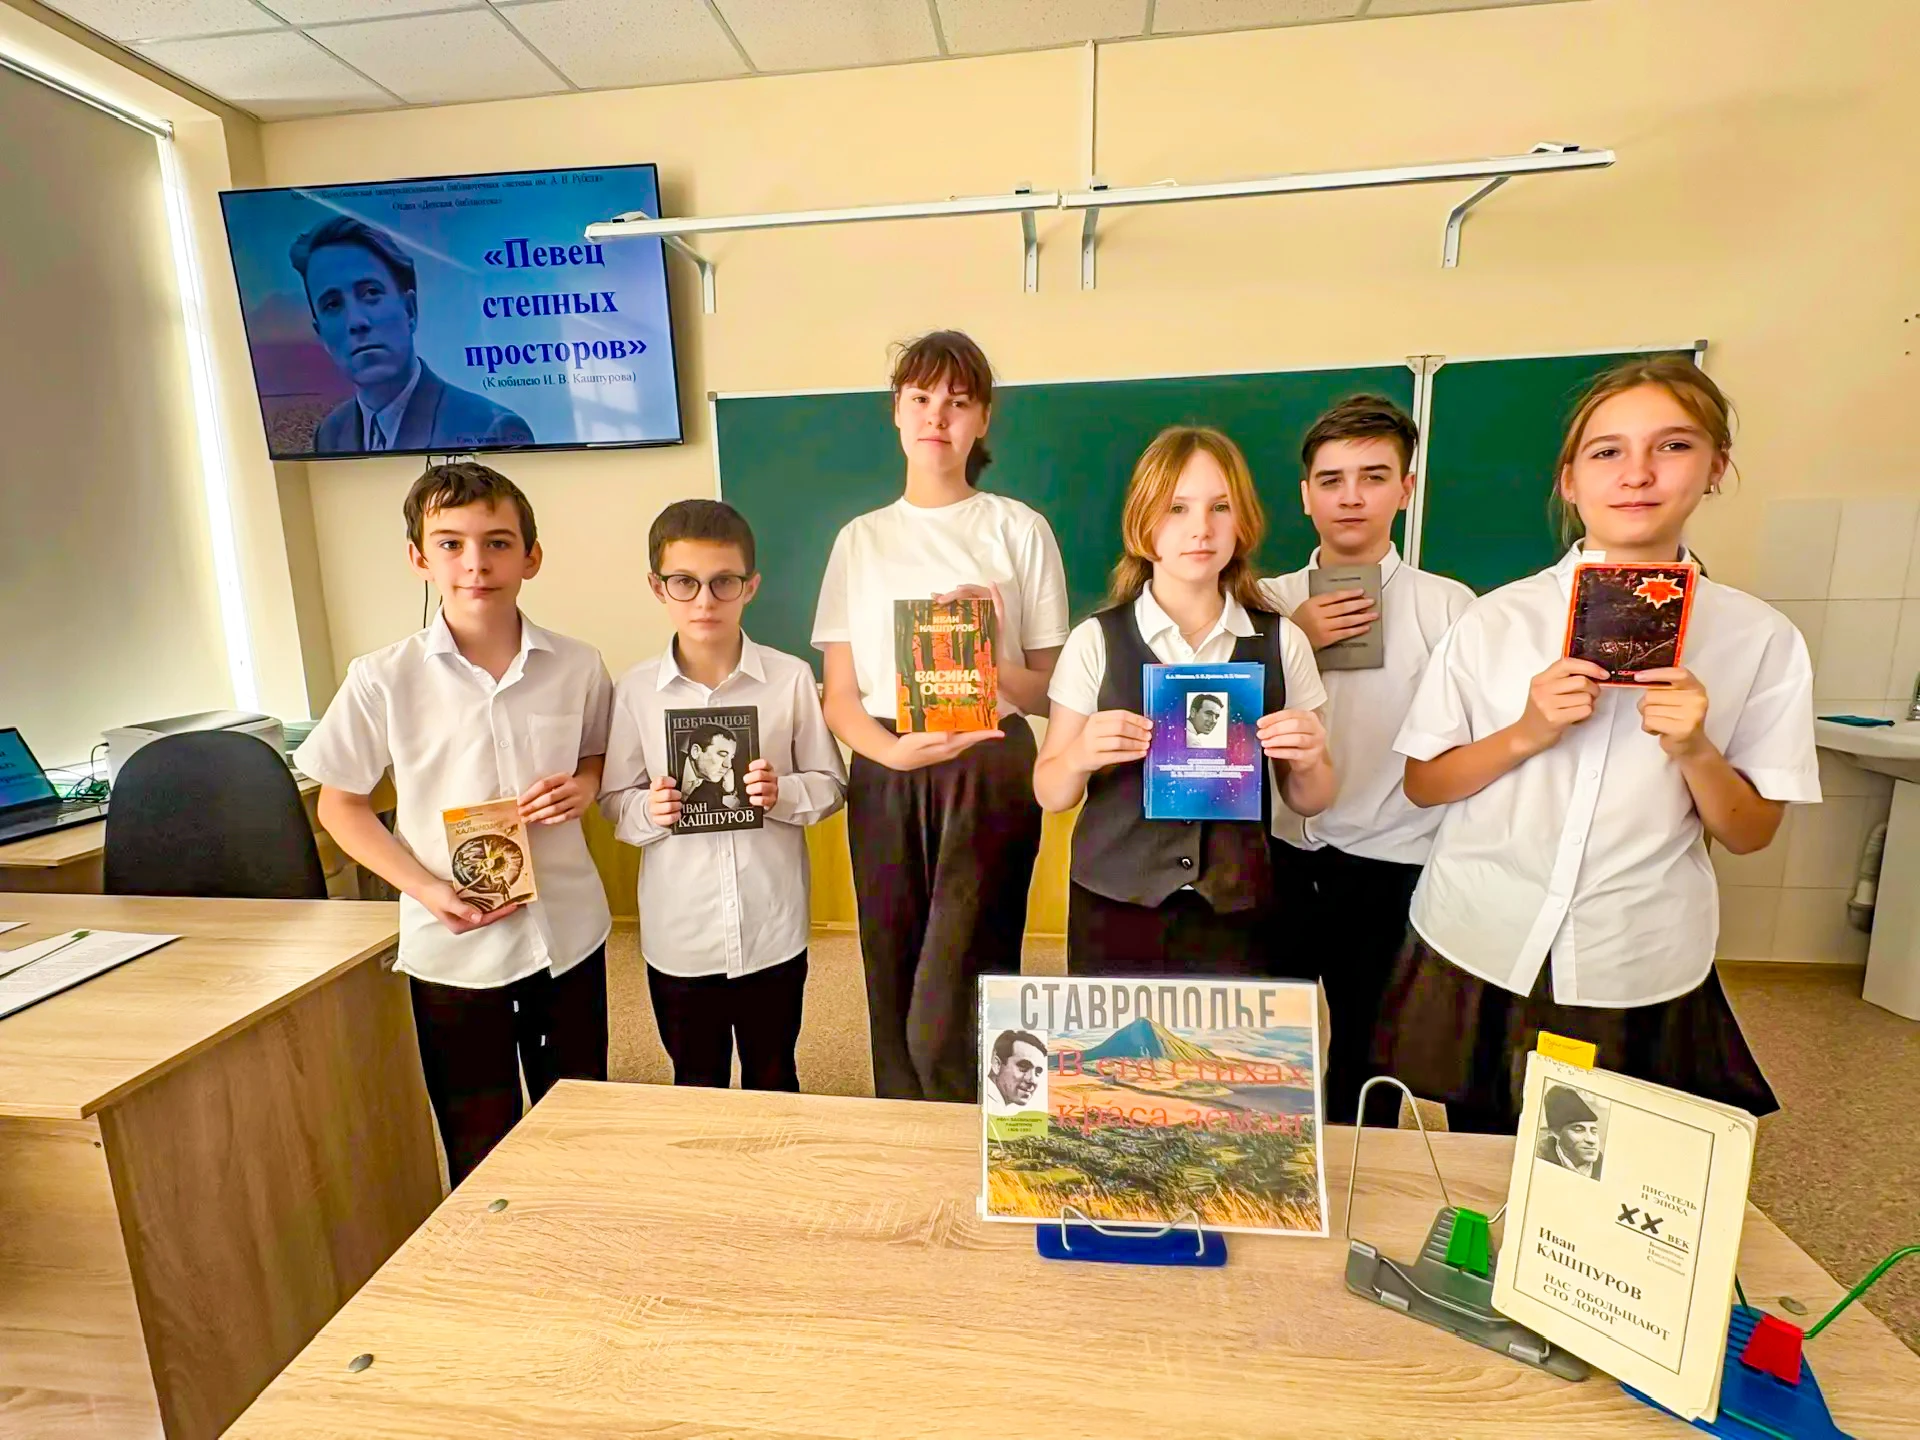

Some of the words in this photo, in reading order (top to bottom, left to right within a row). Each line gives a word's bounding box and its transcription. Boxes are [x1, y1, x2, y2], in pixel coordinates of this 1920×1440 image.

[483, 237, 606, 269] «Певец
[483, 291, 619, 319] степных
[465, 340, 647, 374] просторов»
[919, 623, 975, 633] КАШПУРОВ
[932, 616, 960, 624] ИВАН
[914, 669, 981, 683] ВАСИНА
[919, 682, 978, 695] ОСЕНЬ
[679, 810, 755, 828] КАШПУРОВ
[1020, 982, 1277, 1031] СТАВРОПОЛЬЕ
[1056, 1049, 1083, 1077] В
[1056, 1103, 1168, 1137] краса
[1641, 1192, 1649, 1201] И
[1653, 1196, 1688, 1217] ЭПОХА
[1642, 1184, 1697, 1210] ПИСАТЕЛЬ
[1539, 1226, 1576, 1253] Иван
[1667, 1233, 1690, 1250] ВЕК
[1537, 1242, 1642, 1301] КАШПУРОВ
[1543, 1284, 1569, 1302] СТО
[1572, 1297, 1618, 1326] ДОРОГ
[1545, 1273, 1571, 1292] НАС
[1576, 1288, 1671, 1342] ОБОЛЬЩАЮТ
